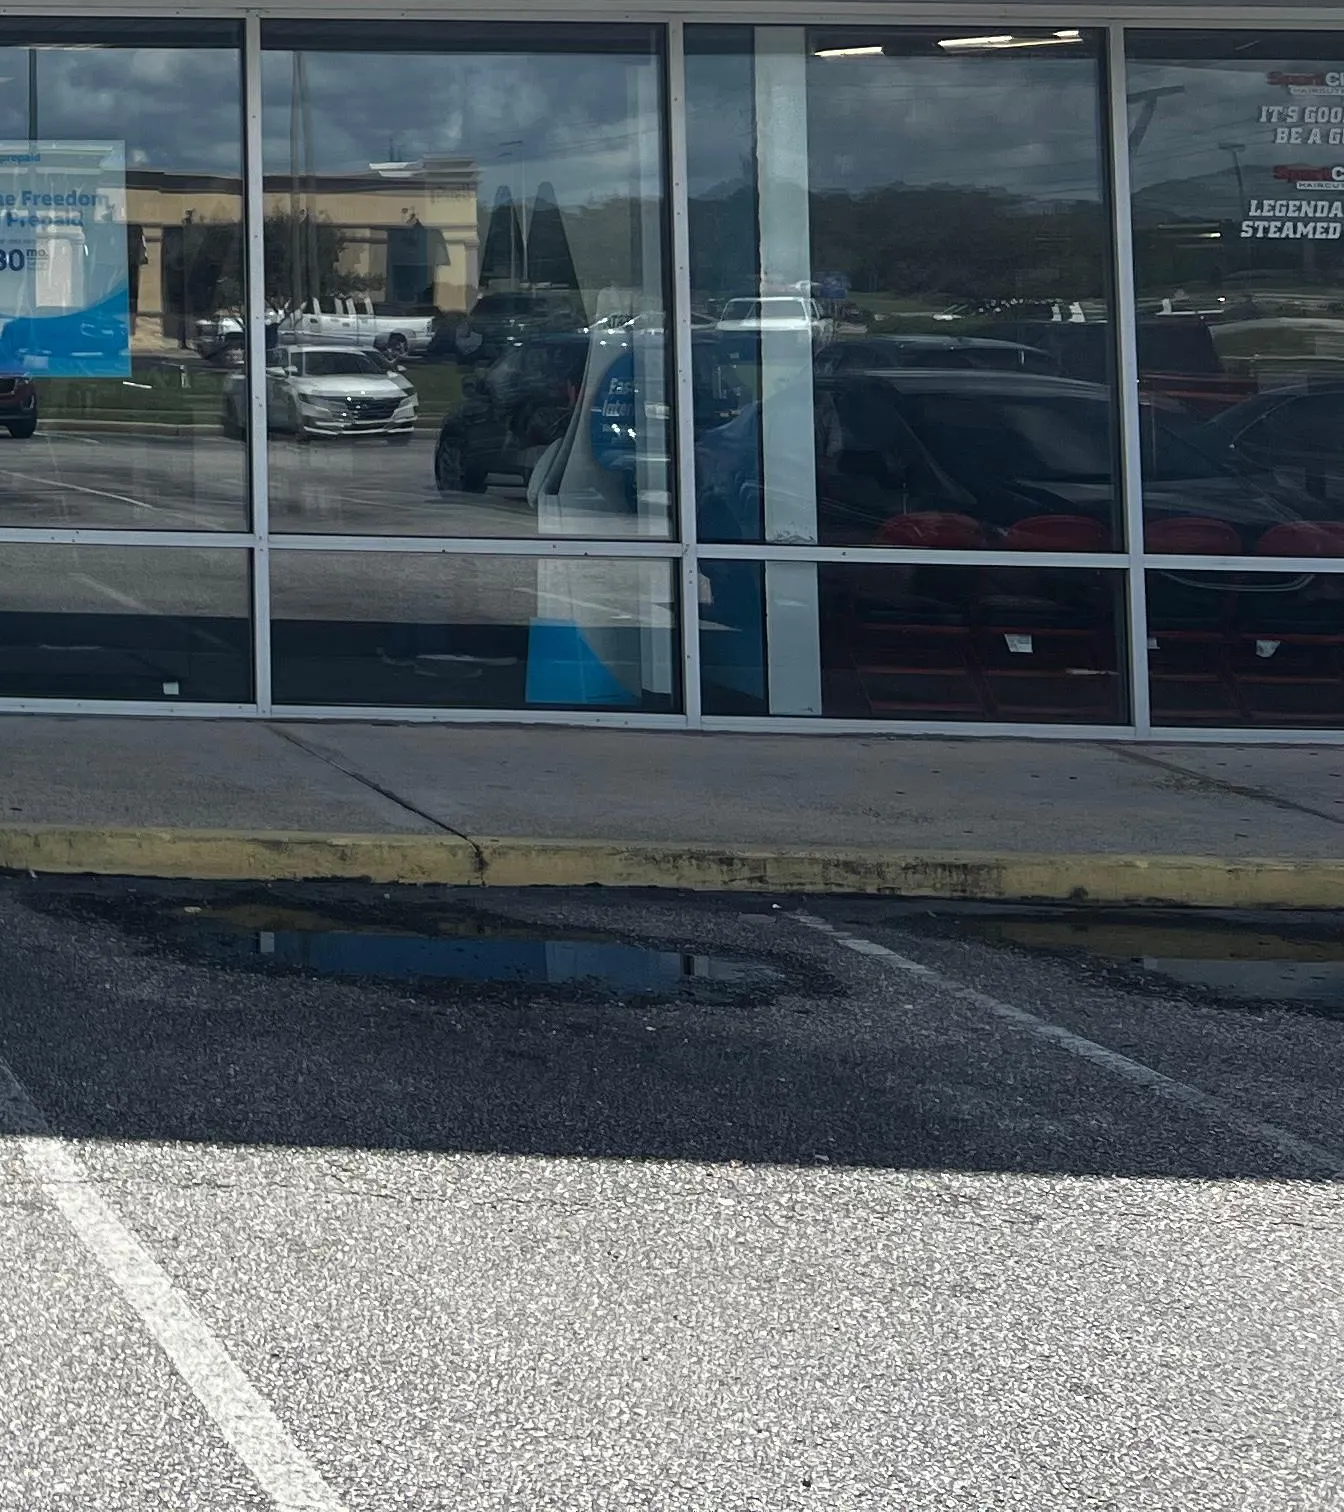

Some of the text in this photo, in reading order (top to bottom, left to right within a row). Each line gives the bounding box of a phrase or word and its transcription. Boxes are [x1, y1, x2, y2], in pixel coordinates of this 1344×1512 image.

[1259, 106, 1344, 123] IT'S GOO
[1274, 127, 1302, 144] BE
[1307, 127, 1322, 144] A
[22, 190, 109, 206] Freedom
[6, 211, 84, 230] Prepaid
[1240, 221, 1342, 239] STEAMED
